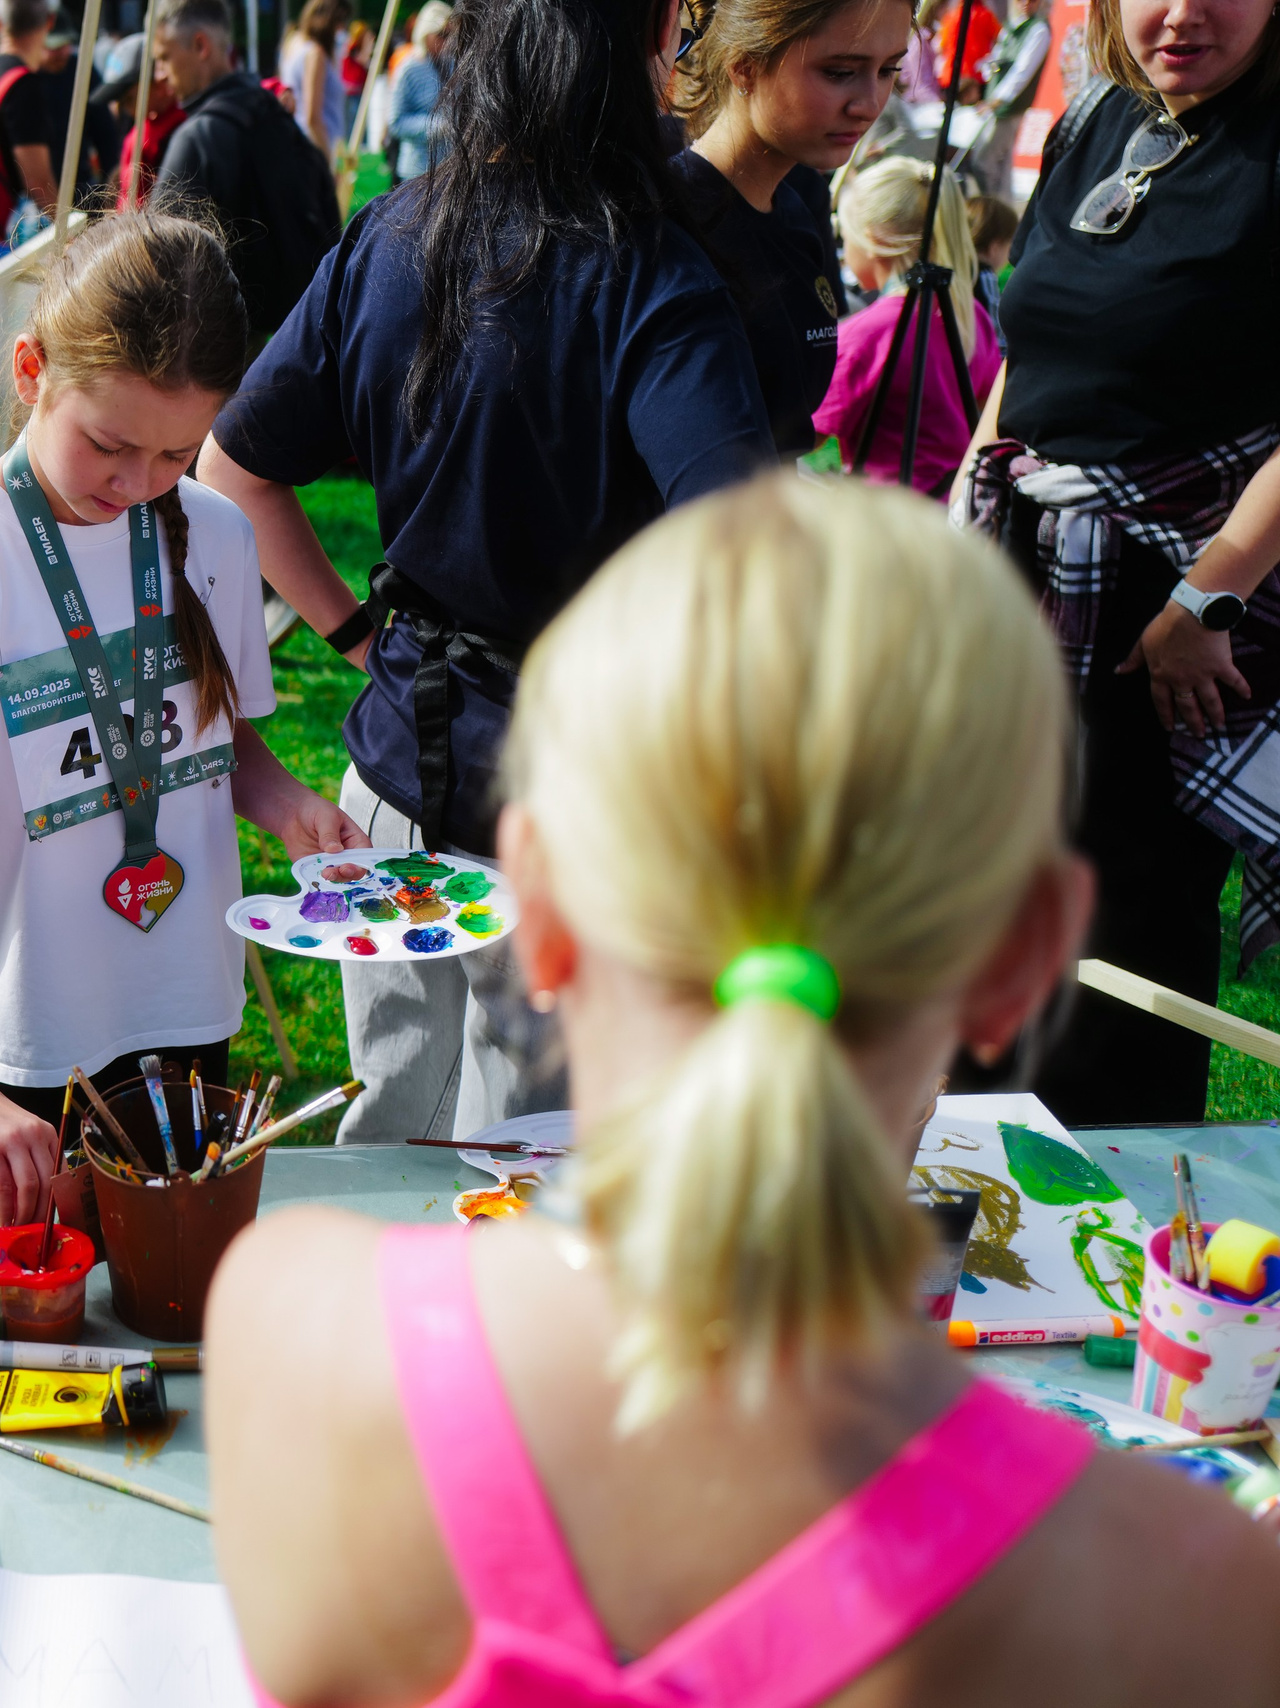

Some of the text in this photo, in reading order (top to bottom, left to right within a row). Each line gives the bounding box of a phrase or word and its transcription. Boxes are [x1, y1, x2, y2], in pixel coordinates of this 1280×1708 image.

[21, 471, 33, 488] 585
[31, 516, 55, 556] MAER
[63, 594, 77, 623] ОГОНЬ
[68, 589, 85, 622] ЖИЗНИ
[7, 678, 71, 706] 14.09.2025
[201, 758, 224, 772] DARS
[137, 886, 174, 901] ЖИЗНИ
[138, 879, 170, 892] ОГОНЬ
[991, 1331, 1077, 1343] edding Textile
